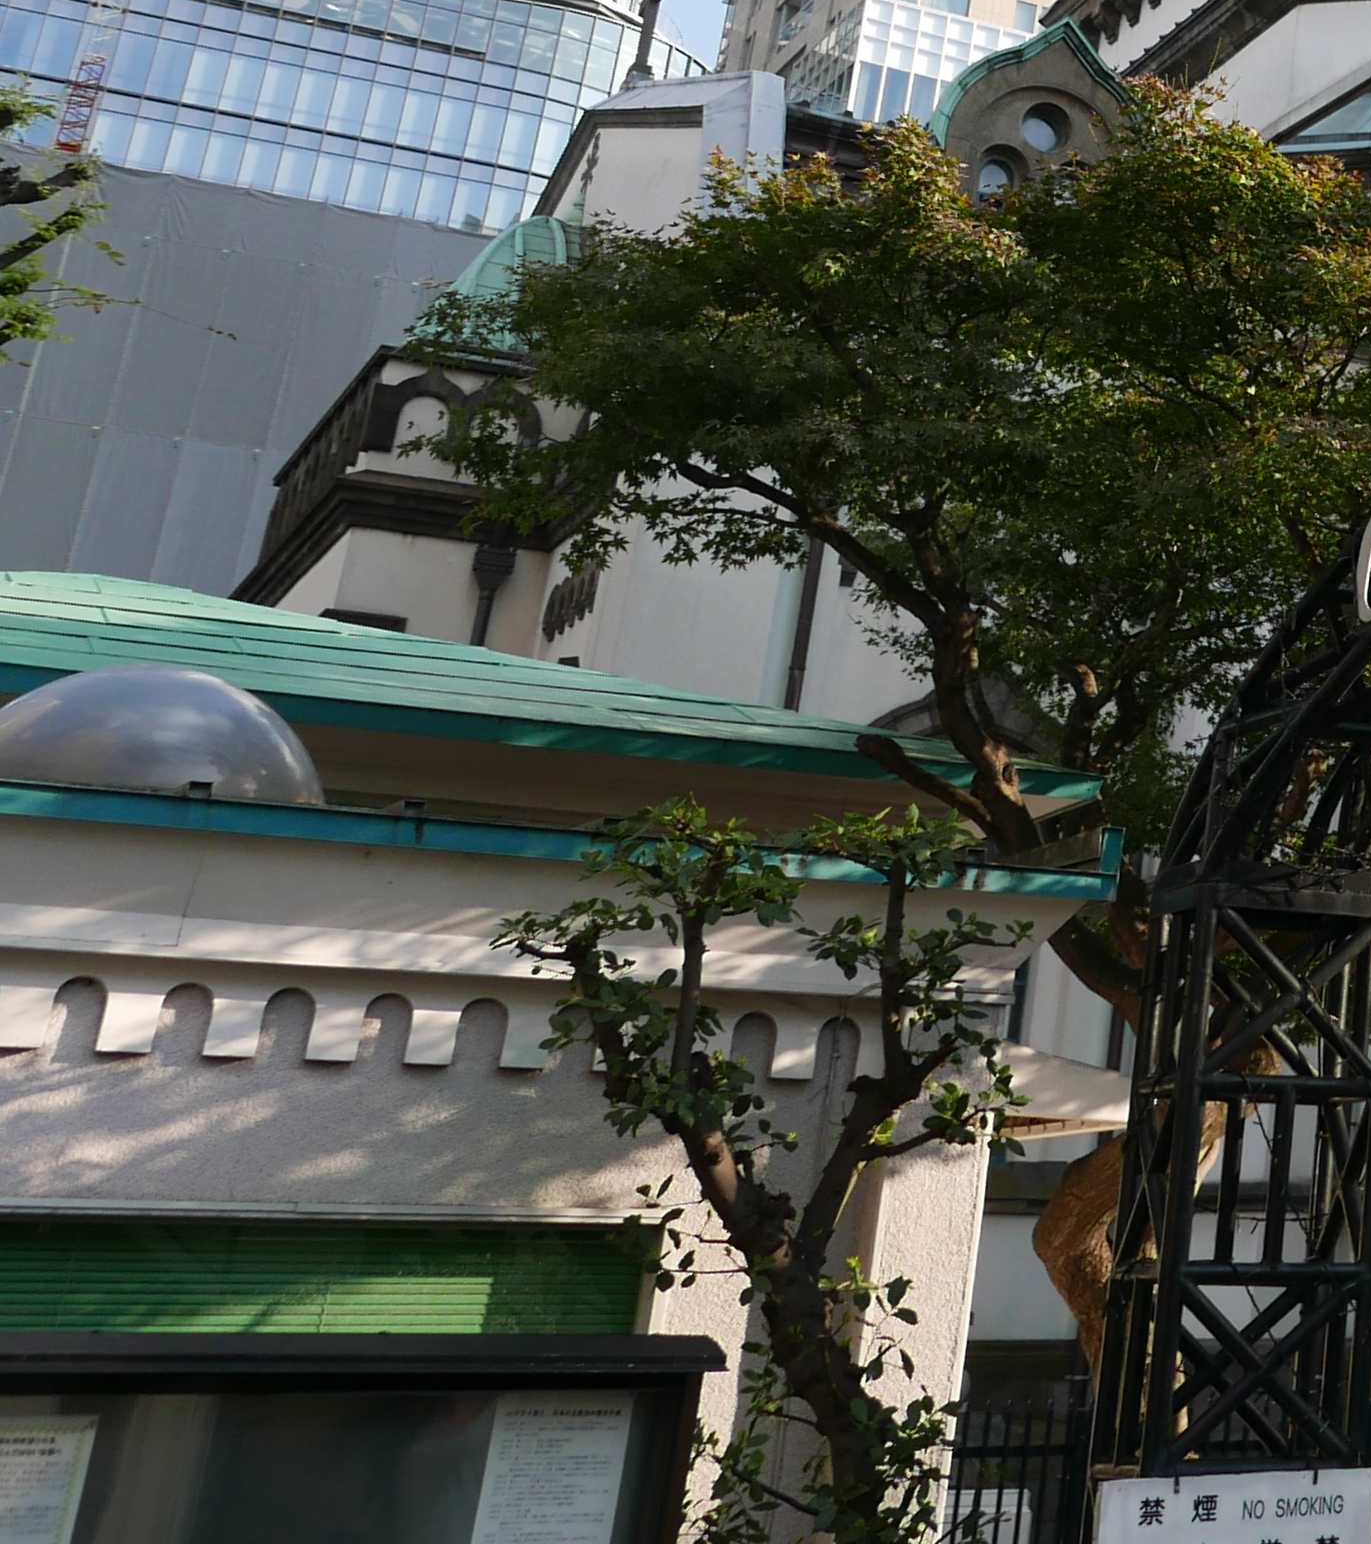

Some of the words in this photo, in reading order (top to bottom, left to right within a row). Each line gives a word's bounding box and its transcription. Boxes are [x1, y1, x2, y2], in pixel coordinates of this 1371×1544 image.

[1138, 1495, 1219, 1526] 禁煙
[1242, 1500, 1265, 1520] NO
[1275, 1495, 1344, 1518] SMOKING
